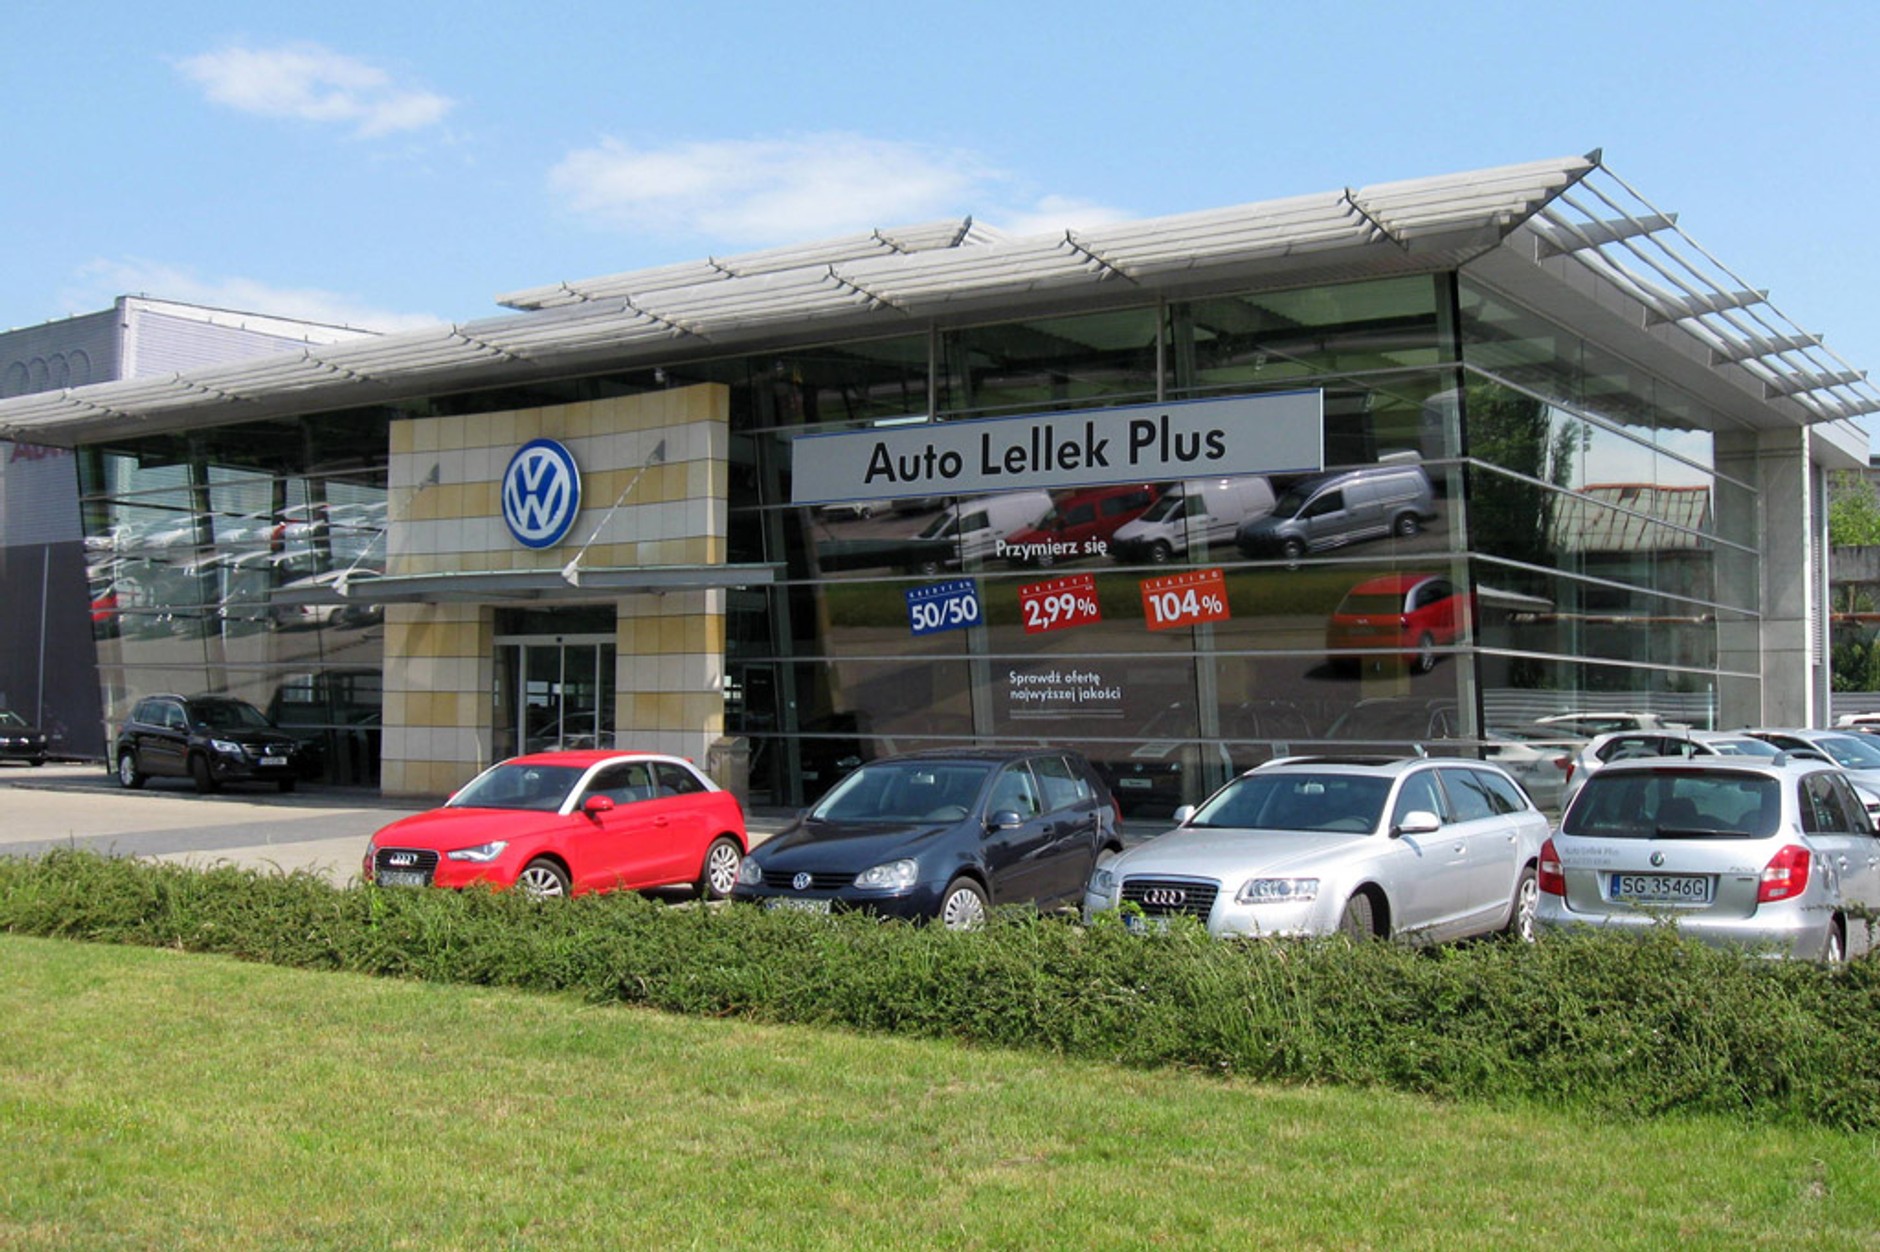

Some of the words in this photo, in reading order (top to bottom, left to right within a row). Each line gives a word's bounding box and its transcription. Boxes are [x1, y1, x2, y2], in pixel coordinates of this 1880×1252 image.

[864, 442, 963, 484] Auto
[981, 421, 1110, 476] Lellek
[1128, 415, 1226, 465] Plus
[995, 537, 1079, 560] Przymierz
[1084, 535, 1108, 557] się
[912, 595, 978, 631] 50/50
[1009, 669, 1061, 686] Sprawdź
[1064, 669, 1101, 686] ofertę
[1010, 686, 1076, 703] najwyższej
[1078, 686, 1122, 703] jakości
[1622, 877, 1645, 894] SG
[1652, 878, 1704, 896] 3546G
